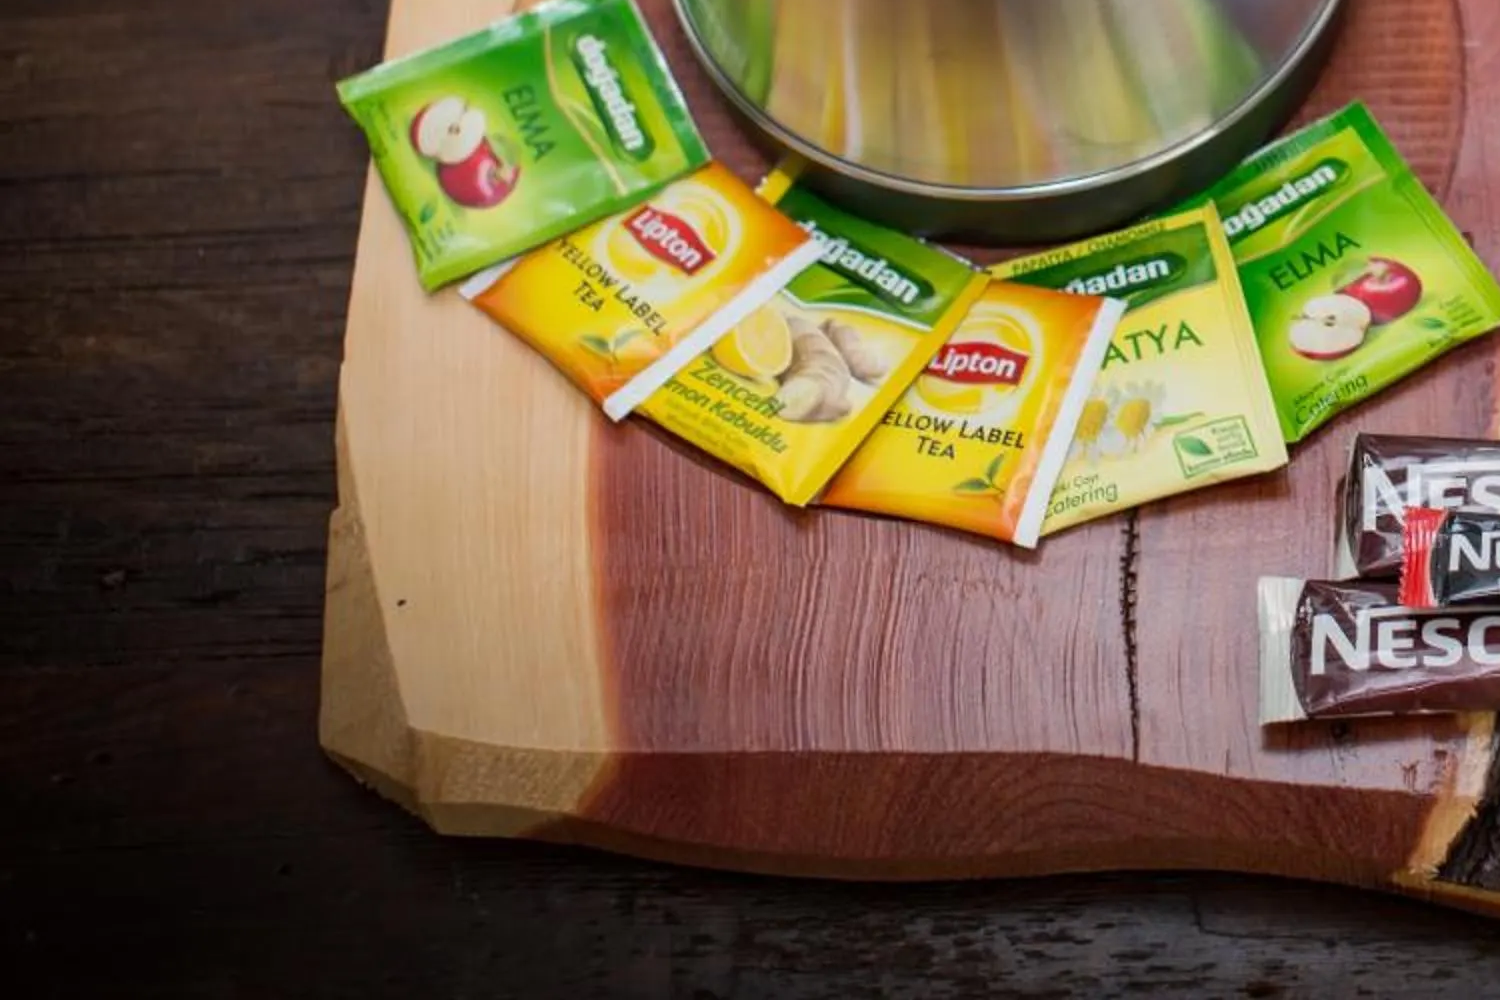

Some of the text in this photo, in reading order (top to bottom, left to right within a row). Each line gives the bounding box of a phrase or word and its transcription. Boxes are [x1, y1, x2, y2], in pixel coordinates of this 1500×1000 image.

[503, 84, 556, 162] ELMA
[1223, 165, 1337, 236] oğadan
[631, 209, 702, 268] Lipton
[1269, 232, 1361, 291] ELMA
[574, 280, 604, 311] TEA
[614, 284, 667, 336] LABEL
[928, 347, 1017, 379] Lipton
[1100, 319, 1204, 371] ATYA
[663, 376, 710, 407] mon
[880, 411, 1024, 449] ELLOW LABEL
[917, 435, 955, 459] TEA
